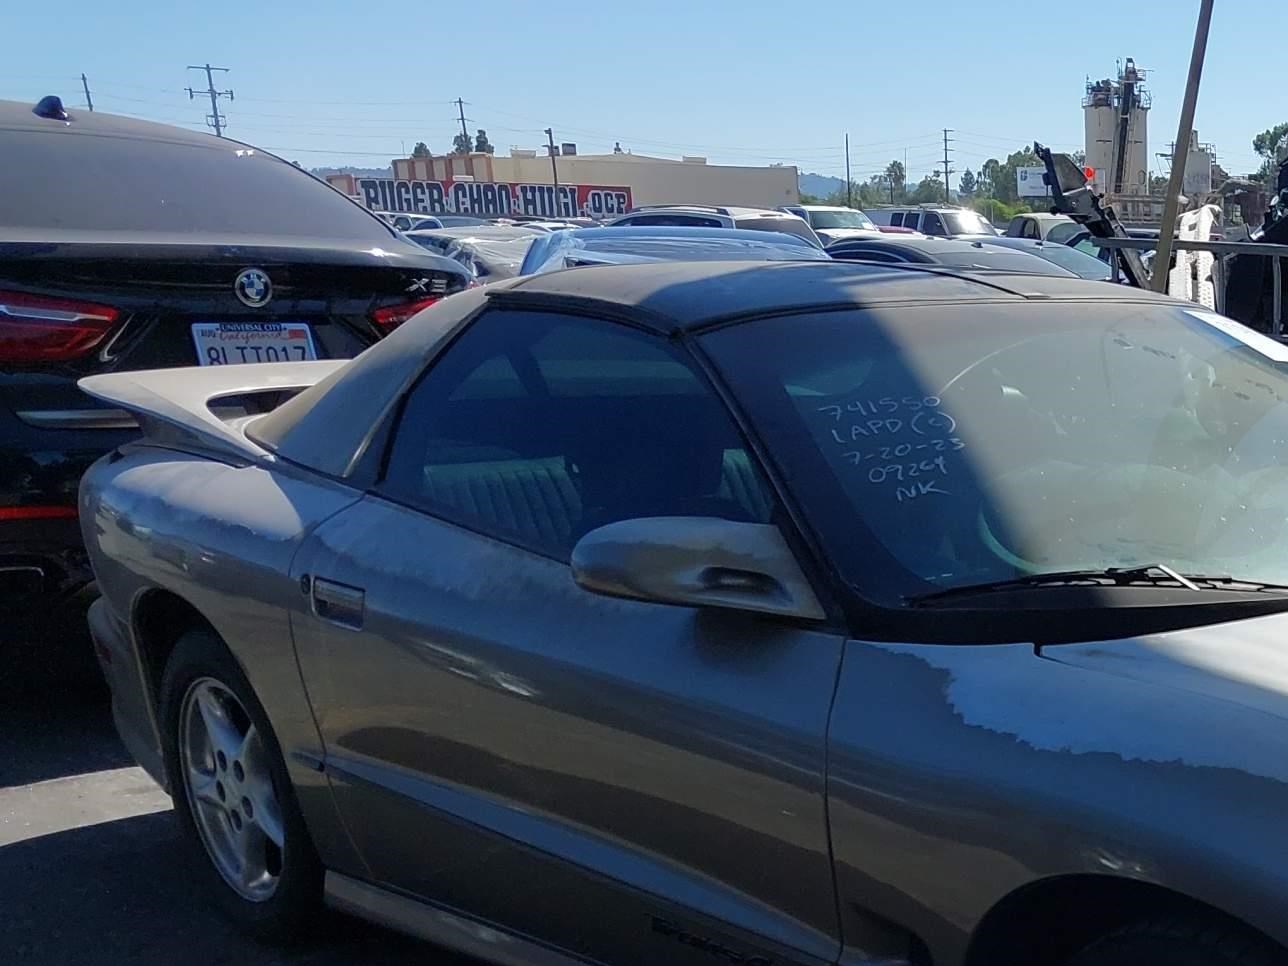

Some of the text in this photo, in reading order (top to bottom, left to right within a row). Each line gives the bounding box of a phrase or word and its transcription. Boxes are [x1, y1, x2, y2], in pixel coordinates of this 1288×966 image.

[591, 192, 627, 214] OCP
[832, 419, 902, 443] LAPD
[895, 480, 950, 501] NK
